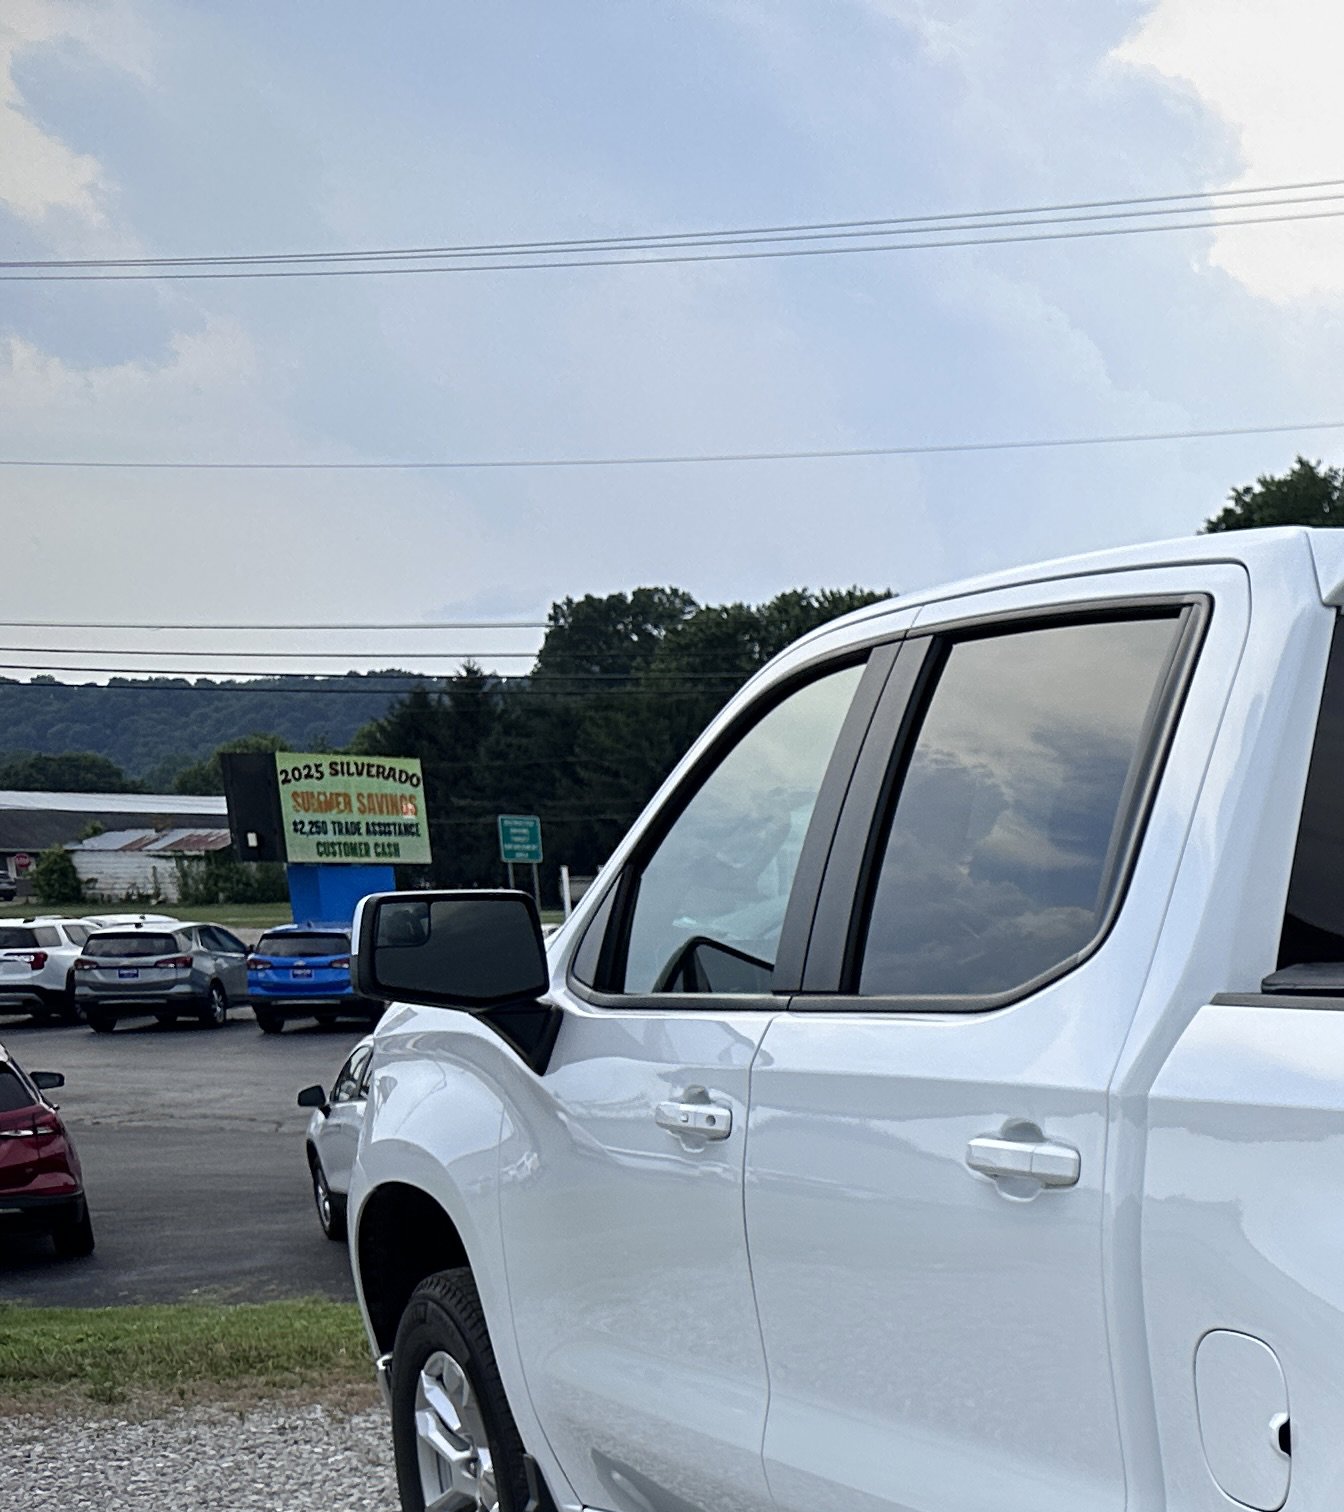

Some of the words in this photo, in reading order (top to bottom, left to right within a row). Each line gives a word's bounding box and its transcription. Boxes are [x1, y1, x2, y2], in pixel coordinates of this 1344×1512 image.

[279, 762, 325, 785] 2025
[328, 761, 421, 788] SILVERADO
[291, 791, 353, 814] SUMMER
[356, 792, 418, 816] SAVINGS
[331, 820, 362, 837] TRADE
[366, 821, 421, 838] ASSISTANCE
[316, 841, 371, 858] CUSTOMER
[374, 842, 401, 858] CASH
